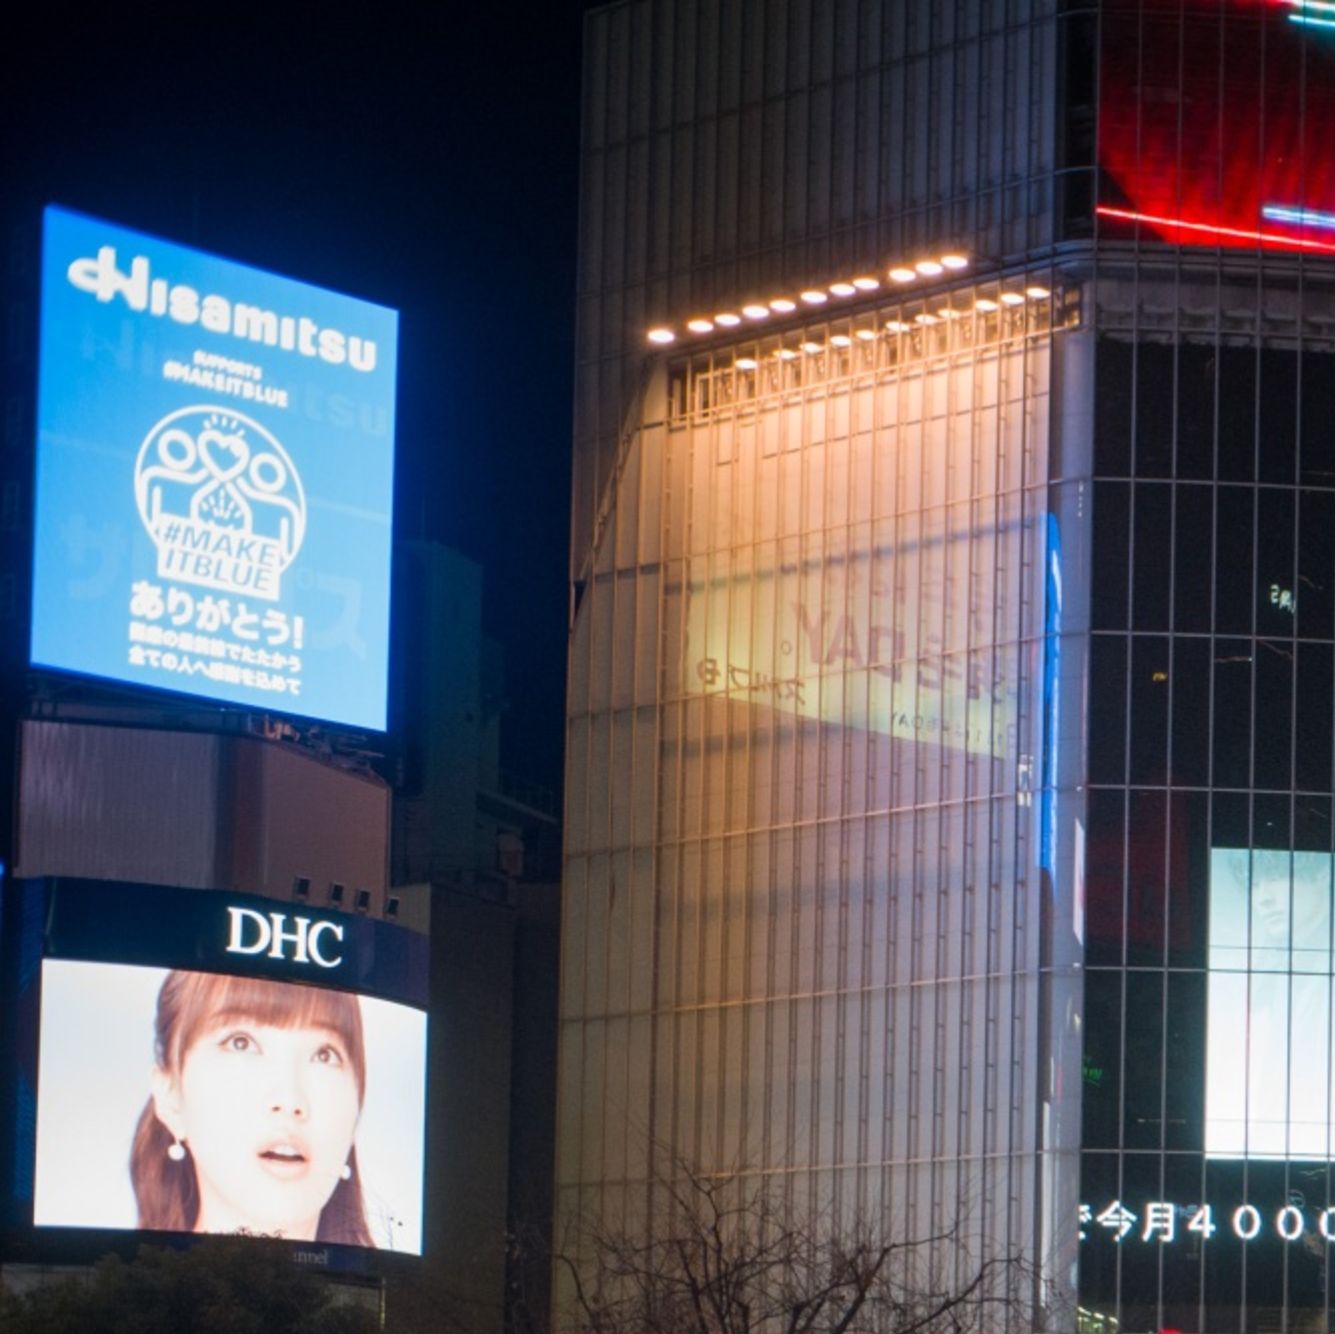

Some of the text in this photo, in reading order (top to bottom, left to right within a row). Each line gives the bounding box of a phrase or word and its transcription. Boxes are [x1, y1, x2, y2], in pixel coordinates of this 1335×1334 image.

[68, 245, 377, 373] Hisamitsu
[164, 521, 278, 568] #MAKE
[165, 548, 273, 592] ITBLUE
[129, 580, 304, 650] ありがとう!
[226, 905, 344, 968] DHC
